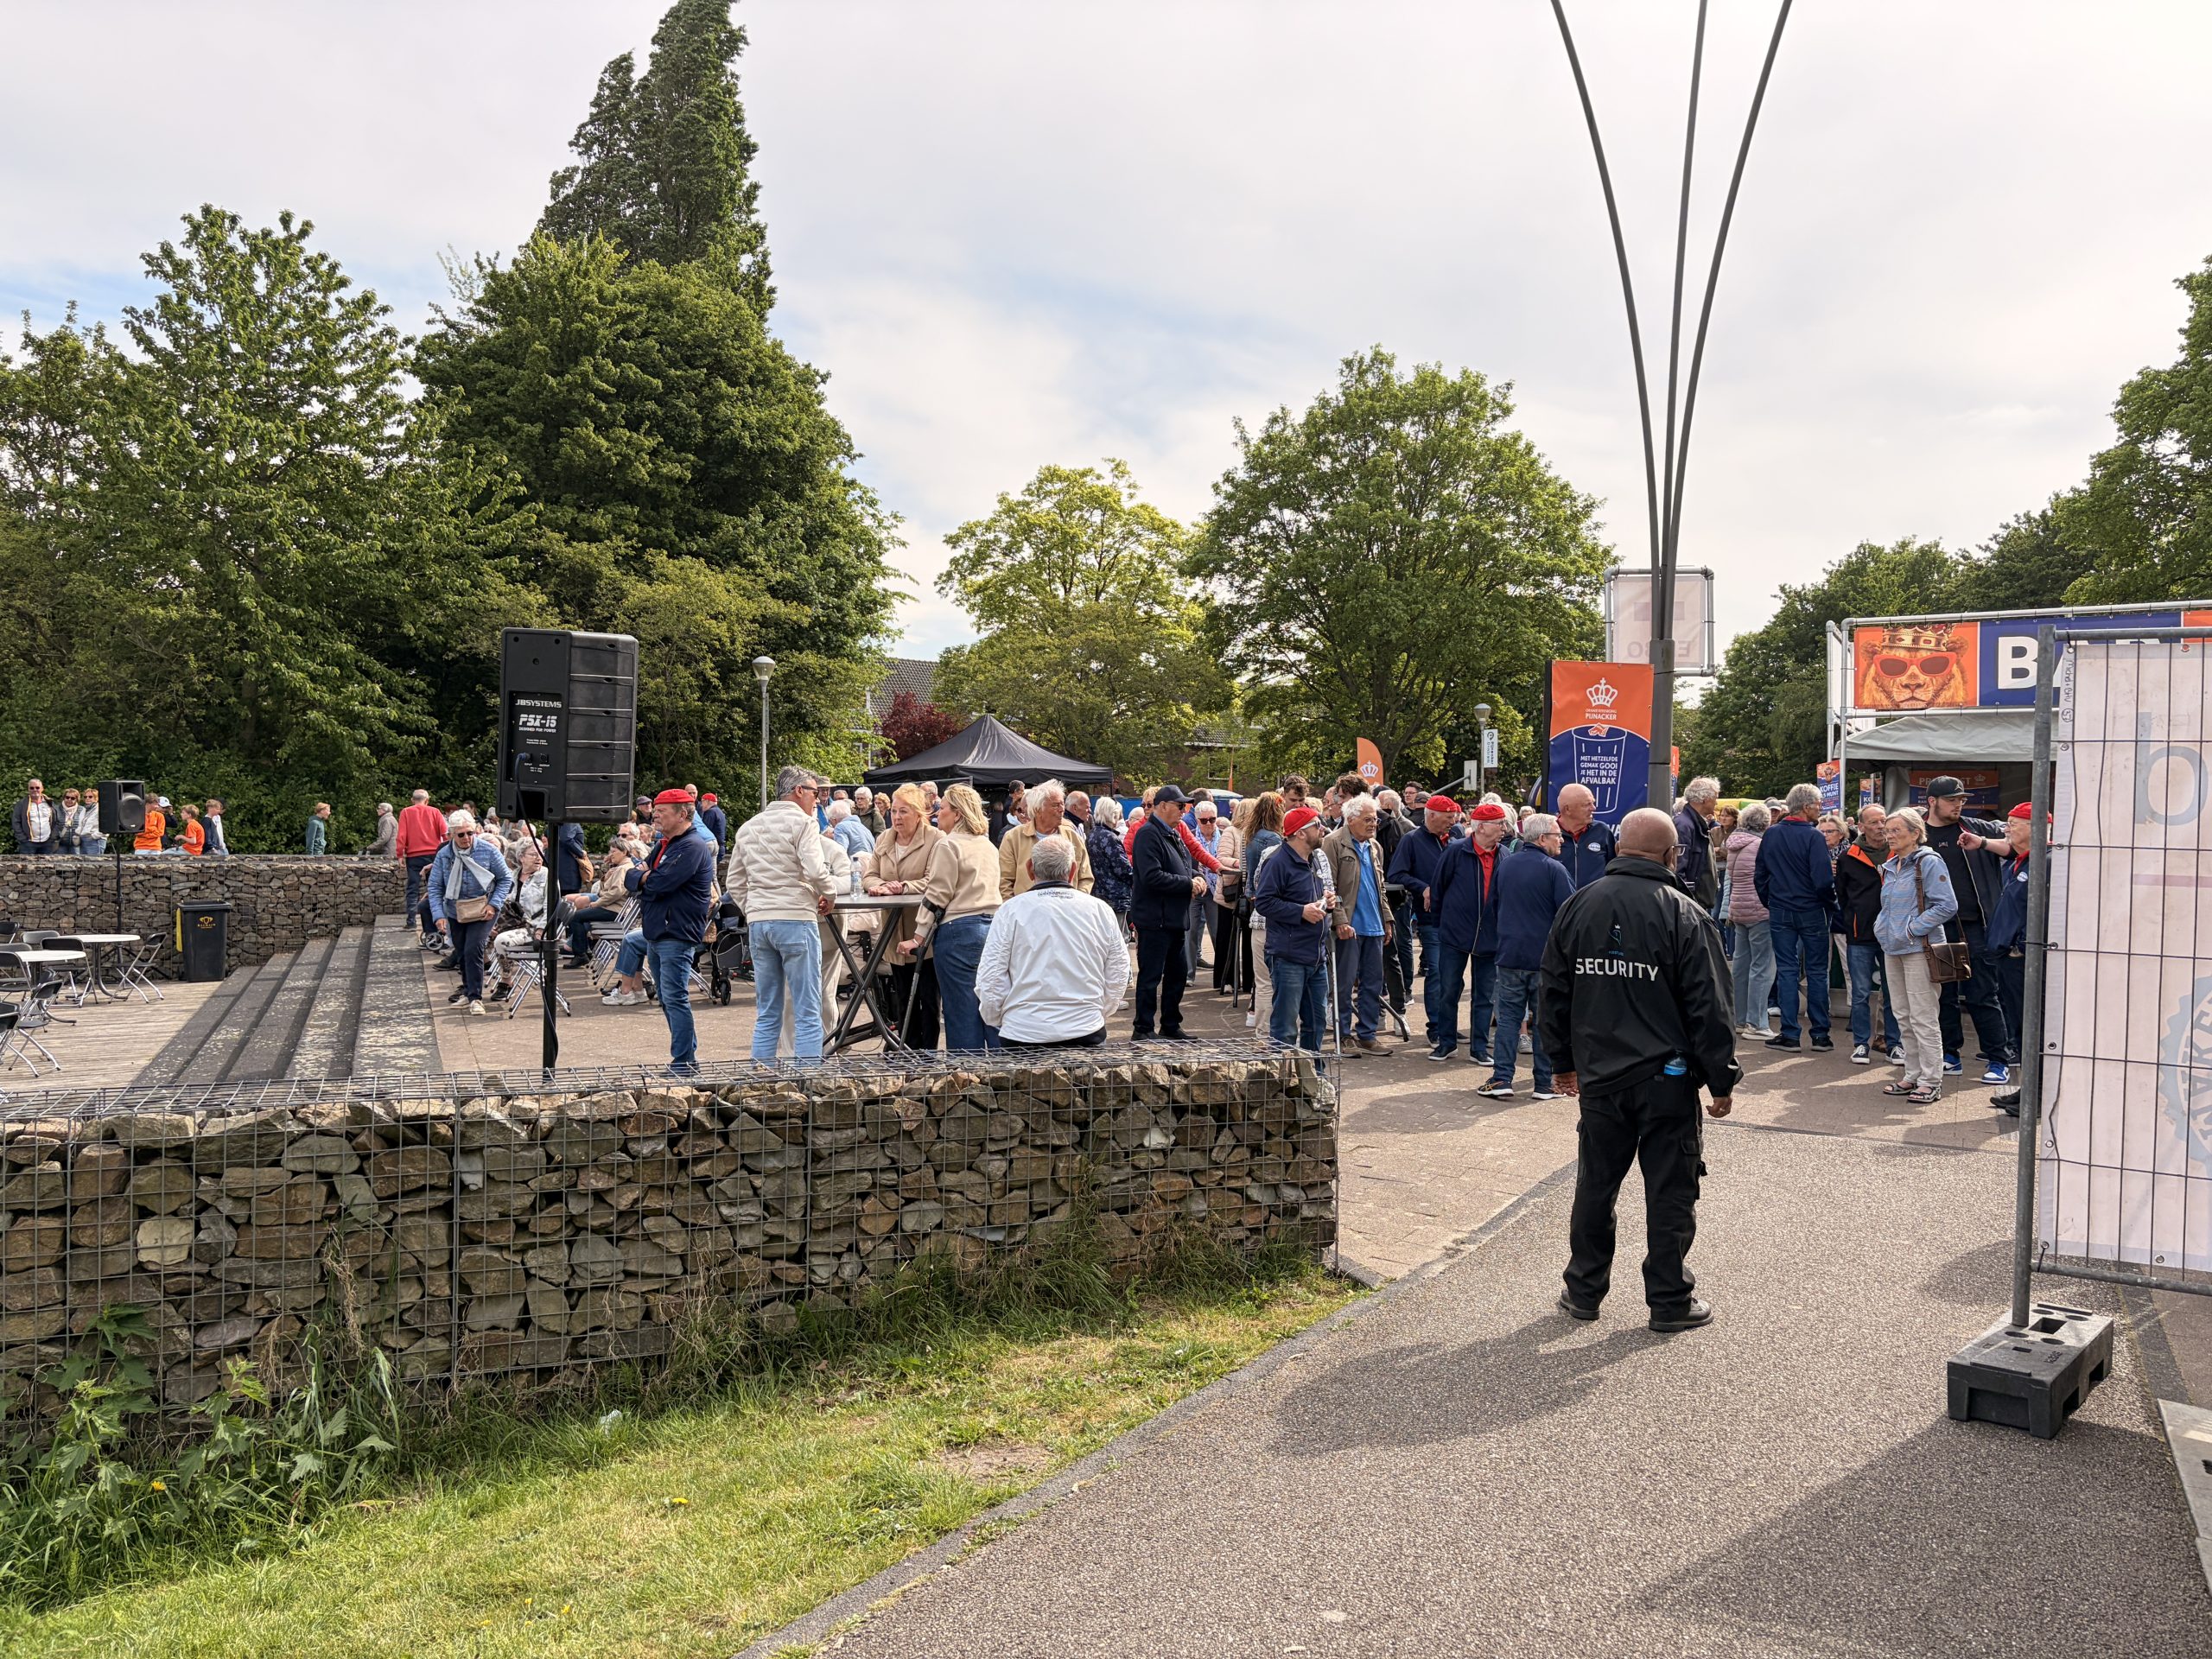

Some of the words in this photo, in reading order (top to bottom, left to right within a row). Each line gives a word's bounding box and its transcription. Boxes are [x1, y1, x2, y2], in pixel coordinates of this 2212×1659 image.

[518, 714, 557, 728] PSX-15
[1819, 783, 1839, 792] KOFFIE
[1574, 957, 1659, 982] SECURITY
